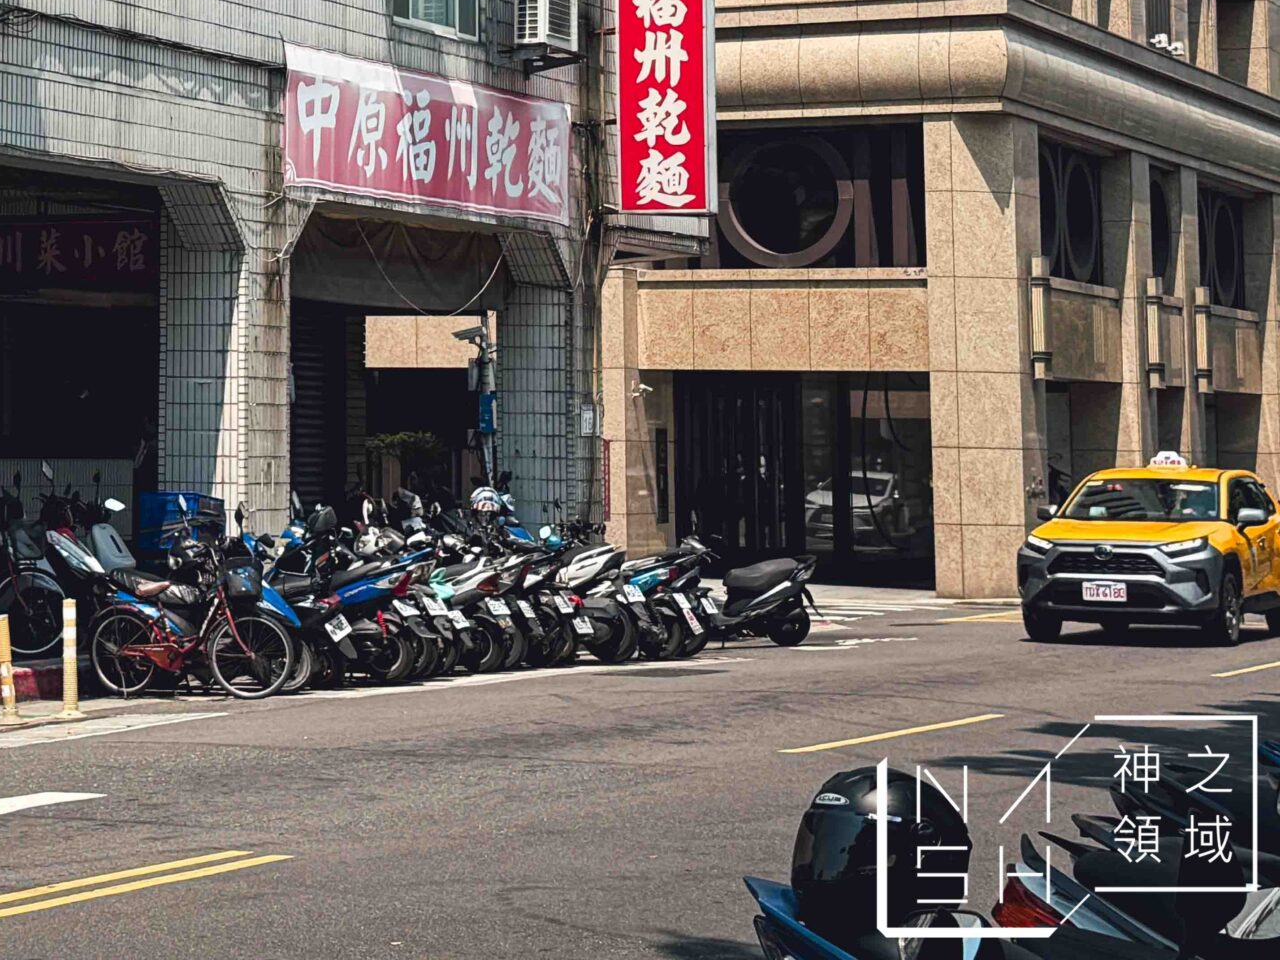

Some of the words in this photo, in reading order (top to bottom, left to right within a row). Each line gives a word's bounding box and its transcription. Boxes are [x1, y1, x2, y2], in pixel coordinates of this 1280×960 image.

[296, 76, 562, 204] 中原福州乾麵
